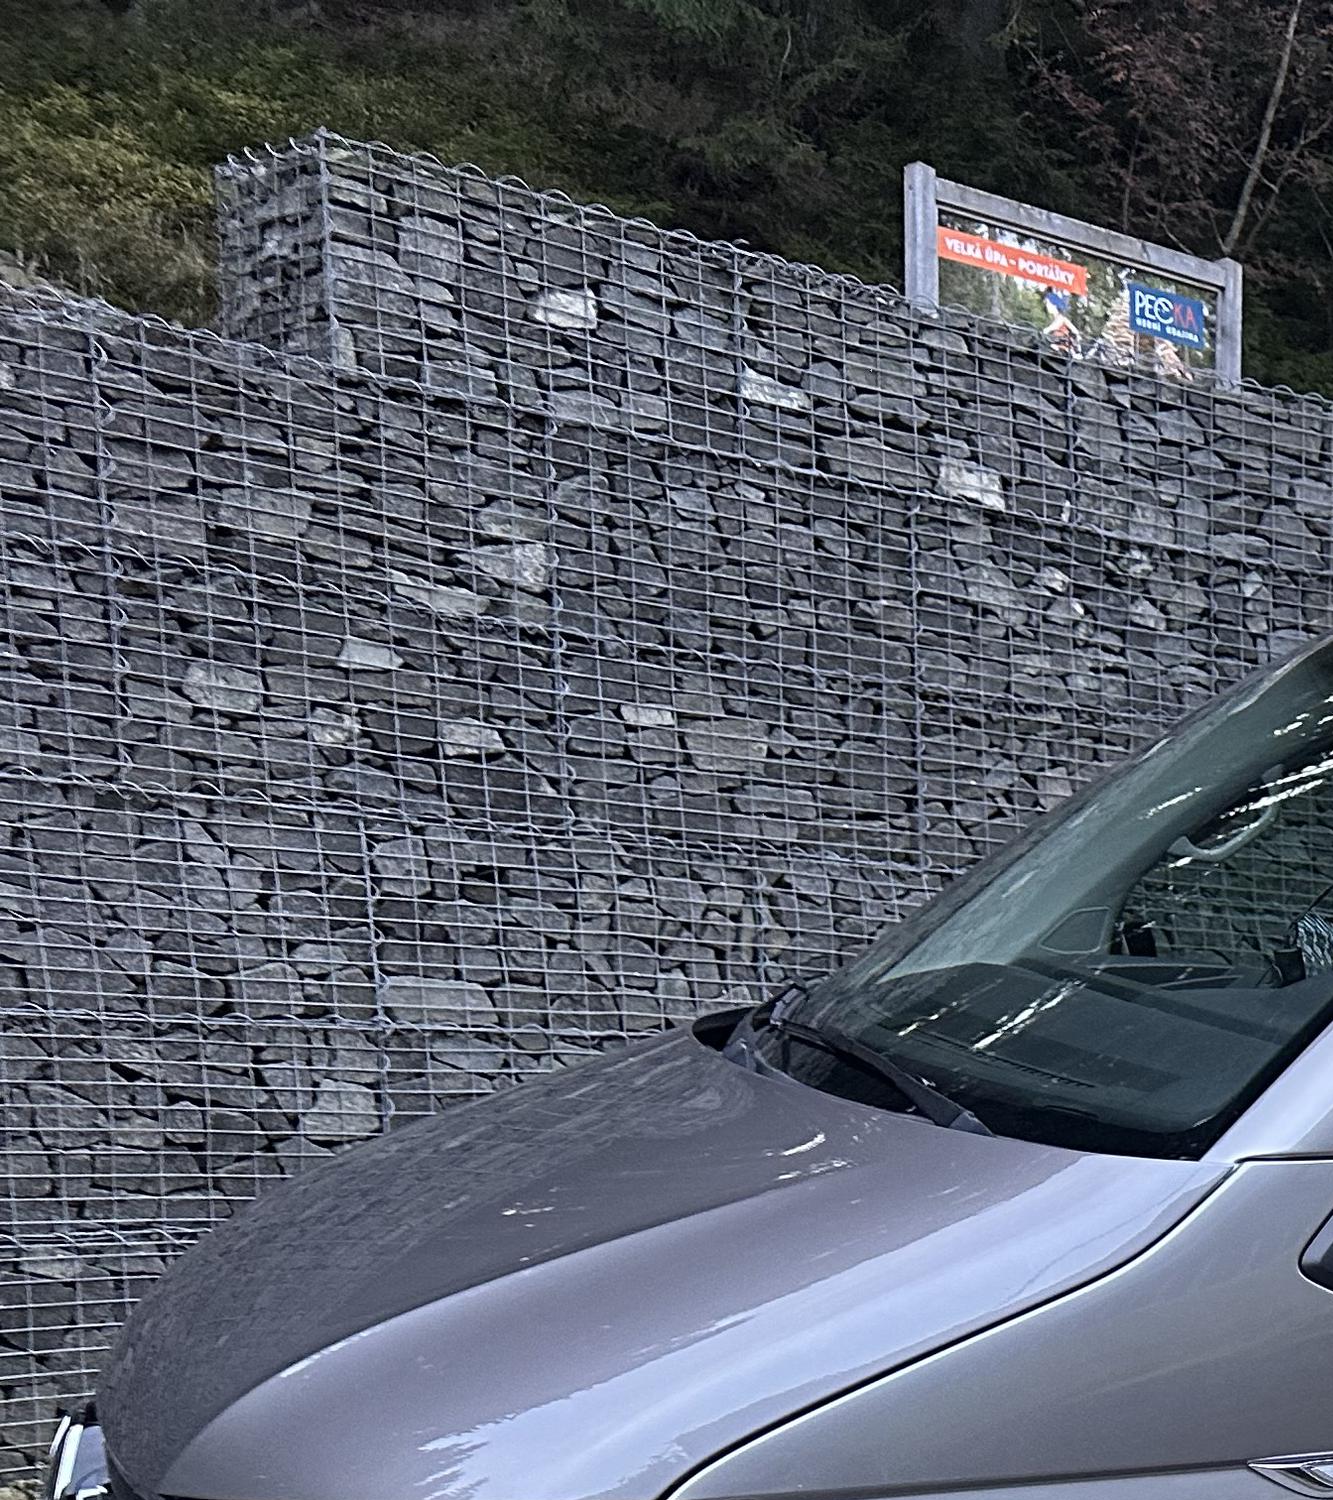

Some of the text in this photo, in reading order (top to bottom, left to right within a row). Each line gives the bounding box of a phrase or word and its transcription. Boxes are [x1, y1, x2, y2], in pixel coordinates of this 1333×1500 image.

[944, 234, 983, 261] VELKÁ
[984, 244, 1009, 268] ÚPA
[1134, 289, 1198, 332] PECKA
